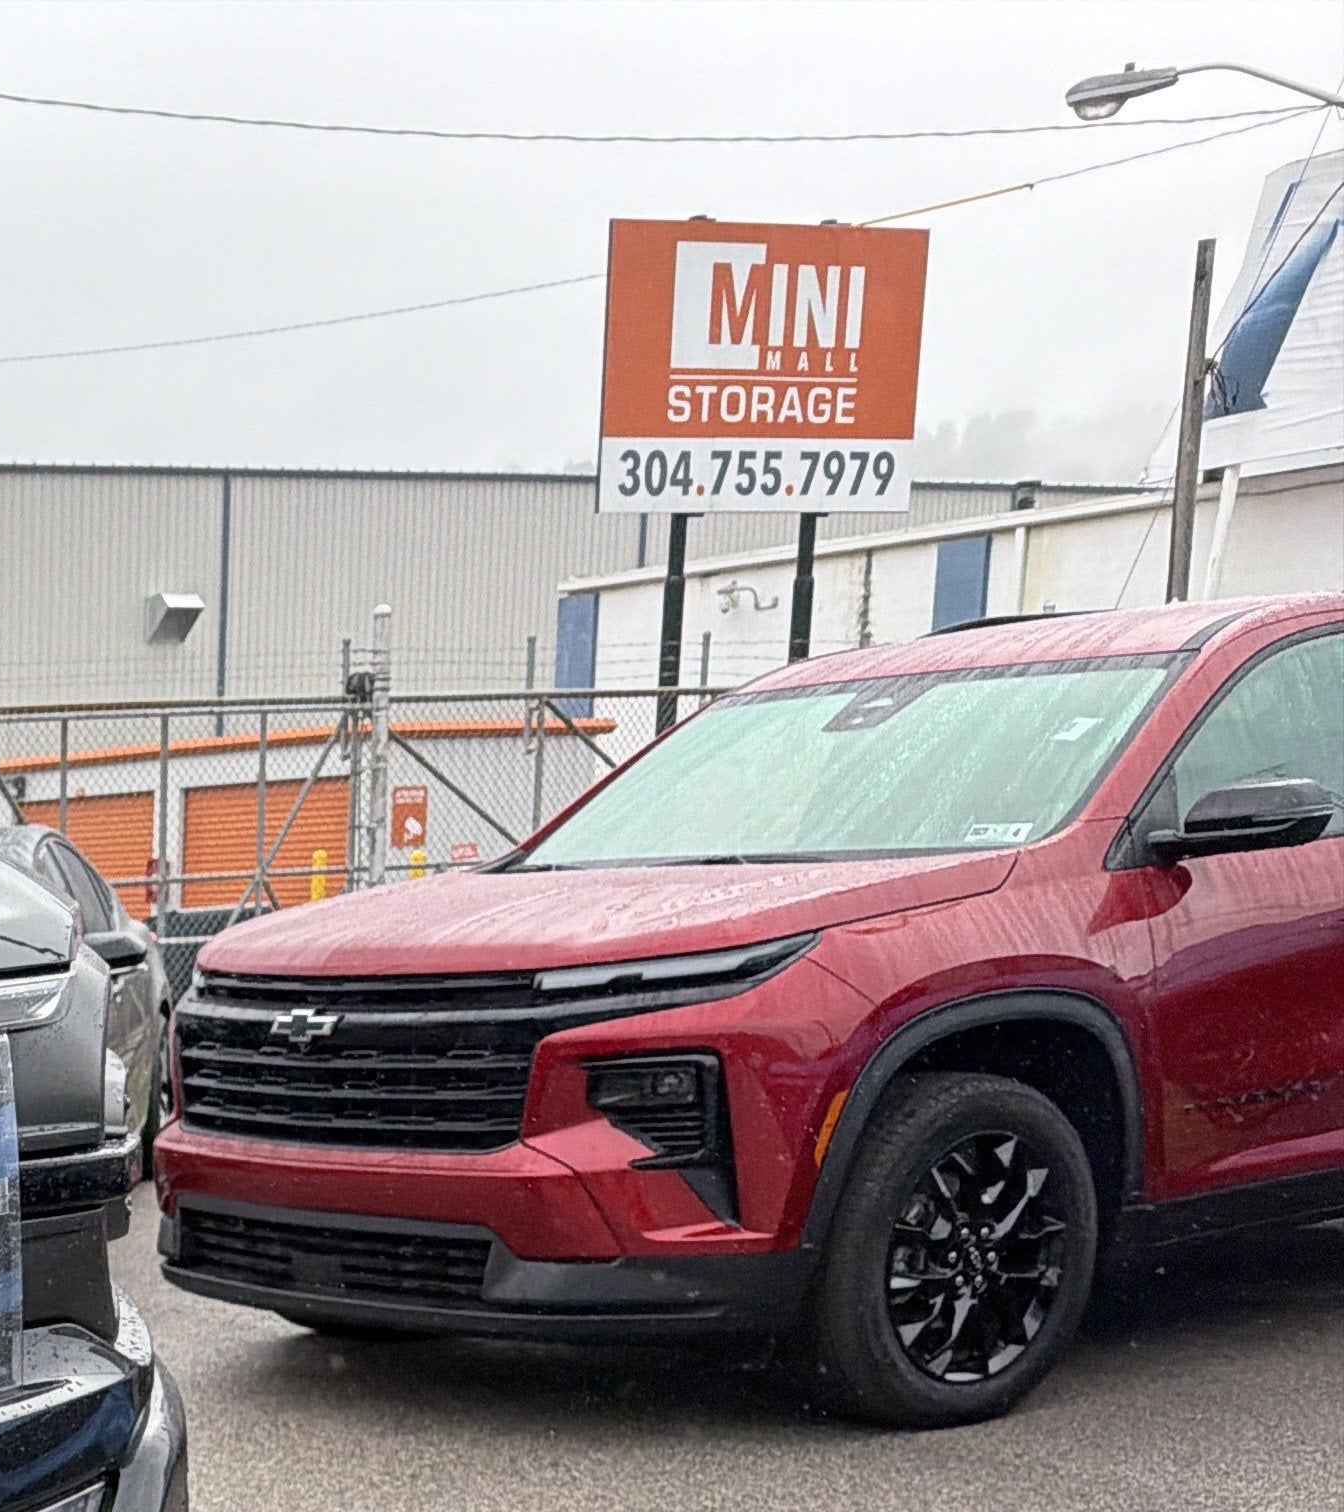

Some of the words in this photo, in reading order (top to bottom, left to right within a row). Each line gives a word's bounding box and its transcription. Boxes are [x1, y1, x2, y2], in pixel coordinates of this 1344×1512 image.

[682, 249, 866, 358] MINI
[765, 351, 858, 373] MALL
[667, 385, 858, 424] STORAGE
[618, 449, 895, 497] 304.755.7979
